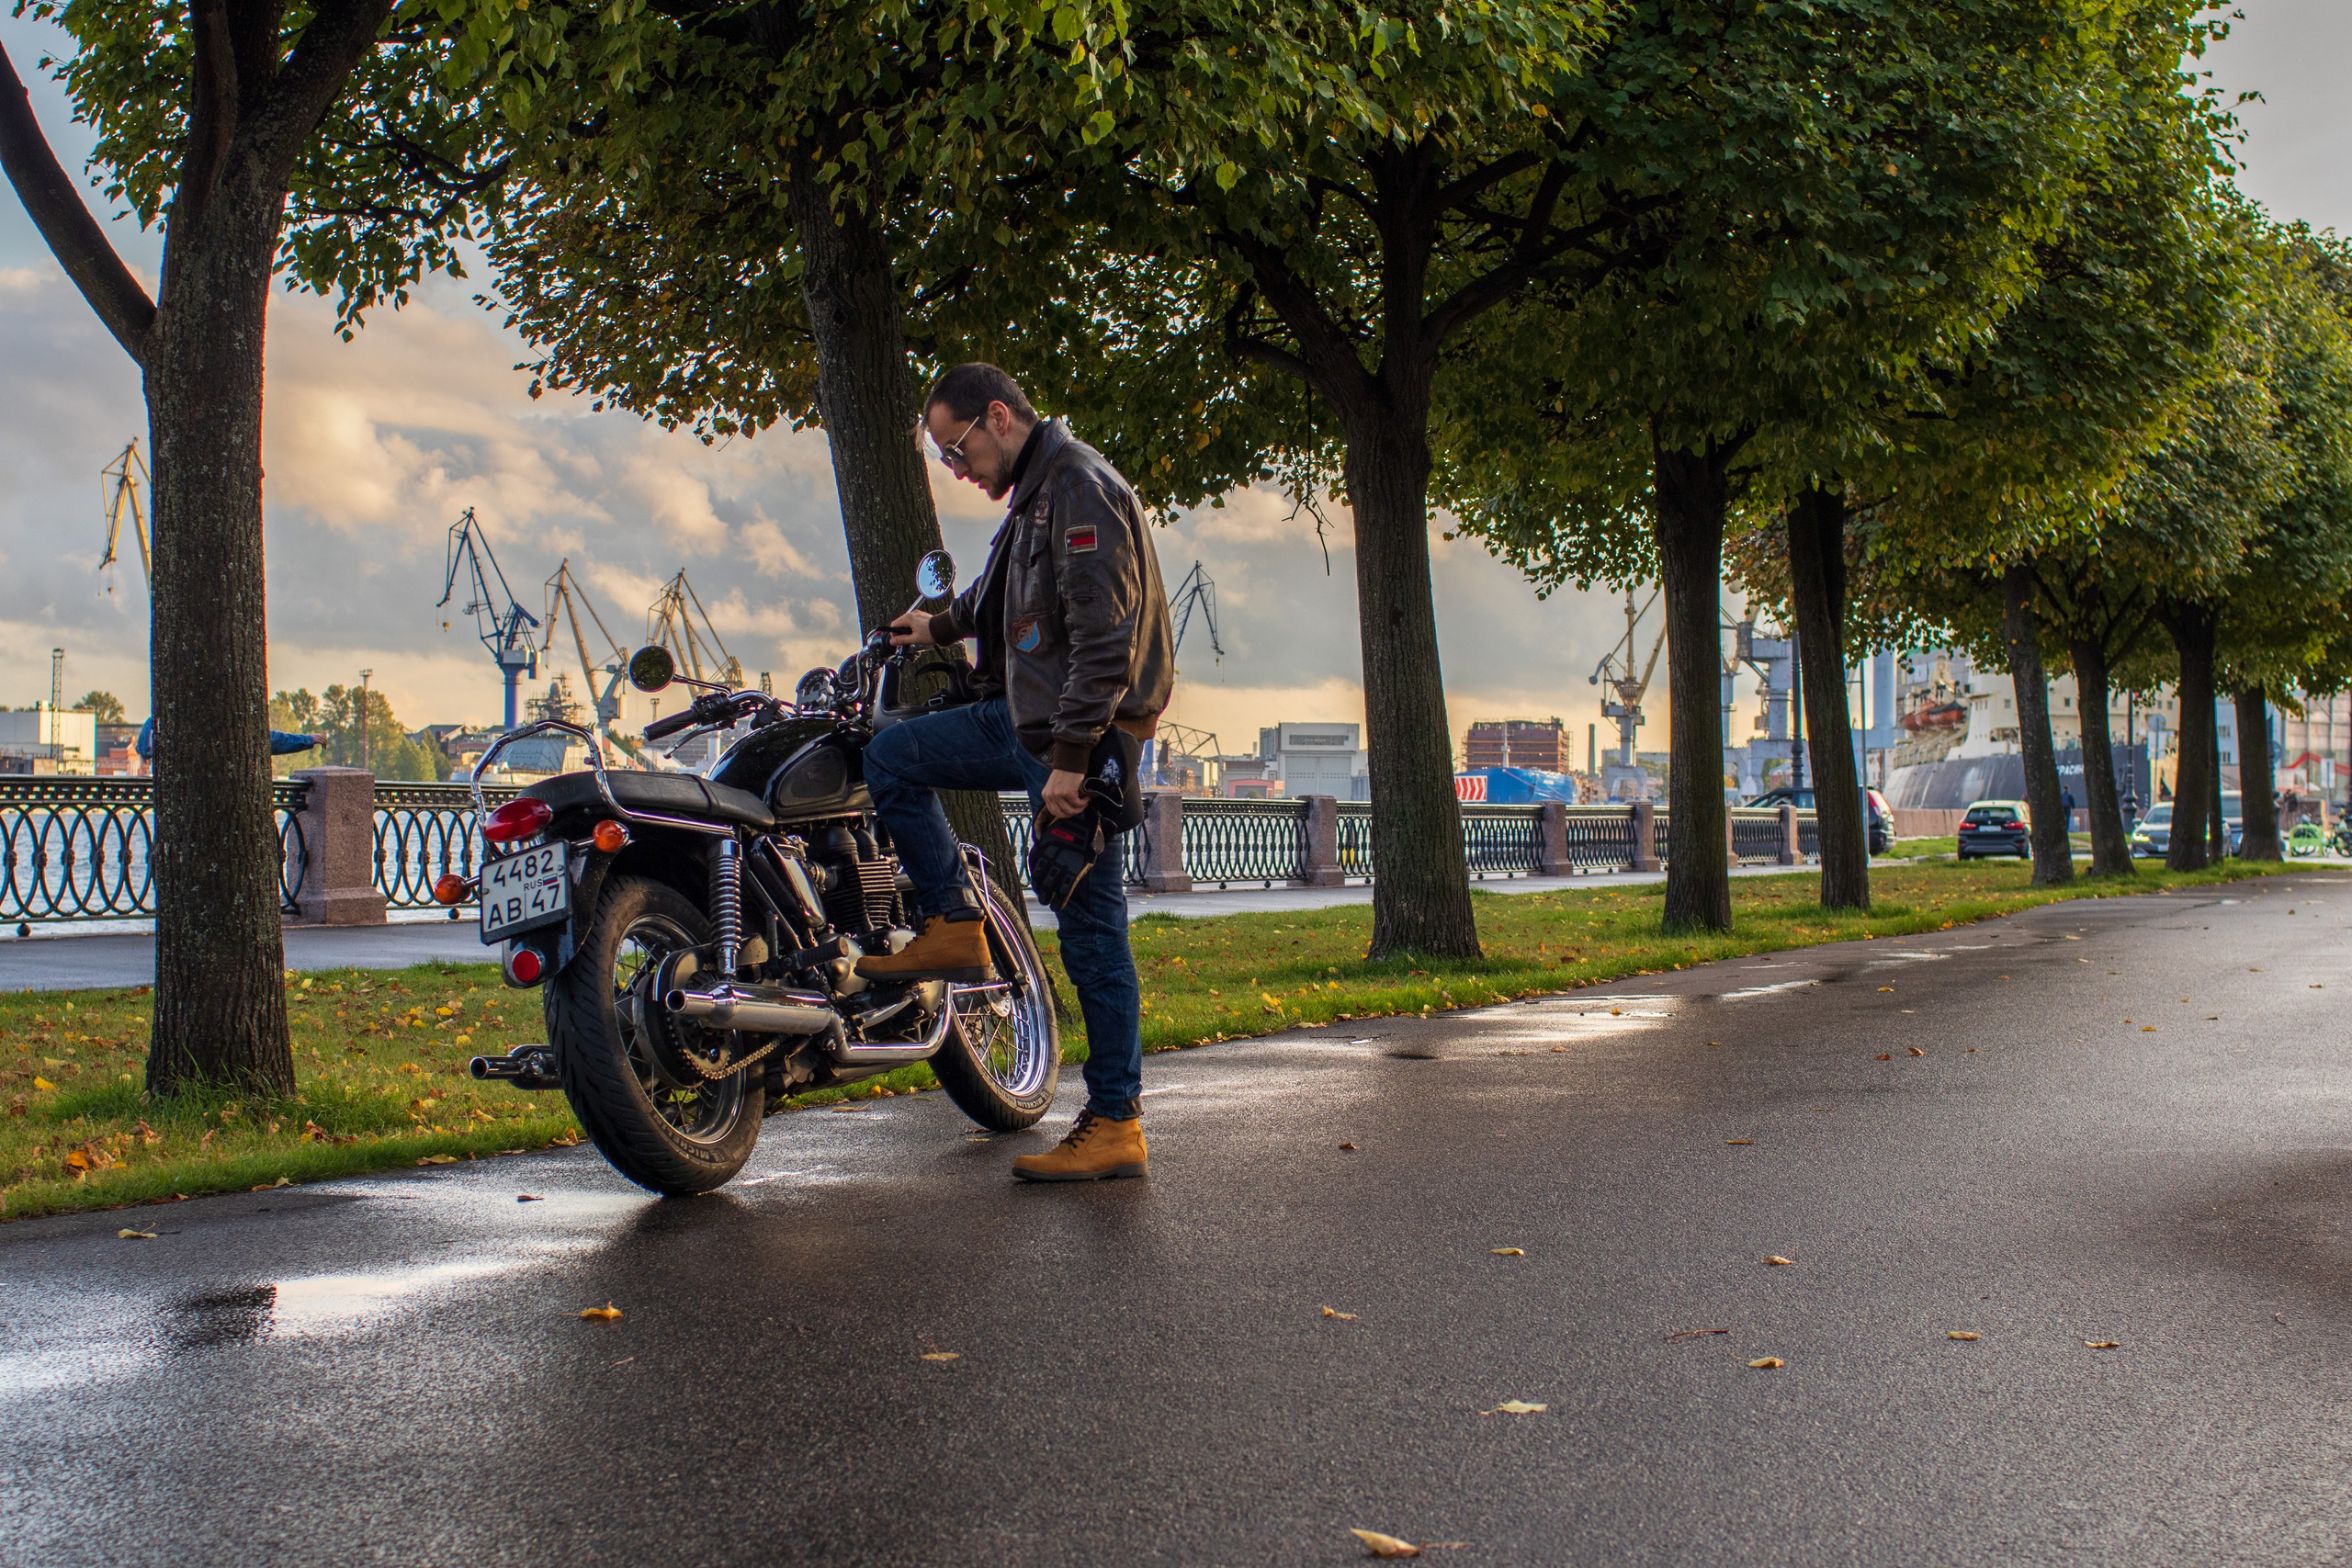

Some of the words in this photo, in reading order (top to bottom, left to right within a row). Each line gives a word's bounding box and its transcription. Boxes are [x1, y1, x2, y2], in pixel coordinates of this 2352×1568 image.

[493, 850, 553, 887] 4482
[524, 878, 542, 891] RUS
[531, 884, 560, 912] 47
[998, 893, 1021, 922] CLASSIC
[1017, 1096, 1044, 1108] MICHELIN
[653, 1113, 710, 1159] MICHELIN
